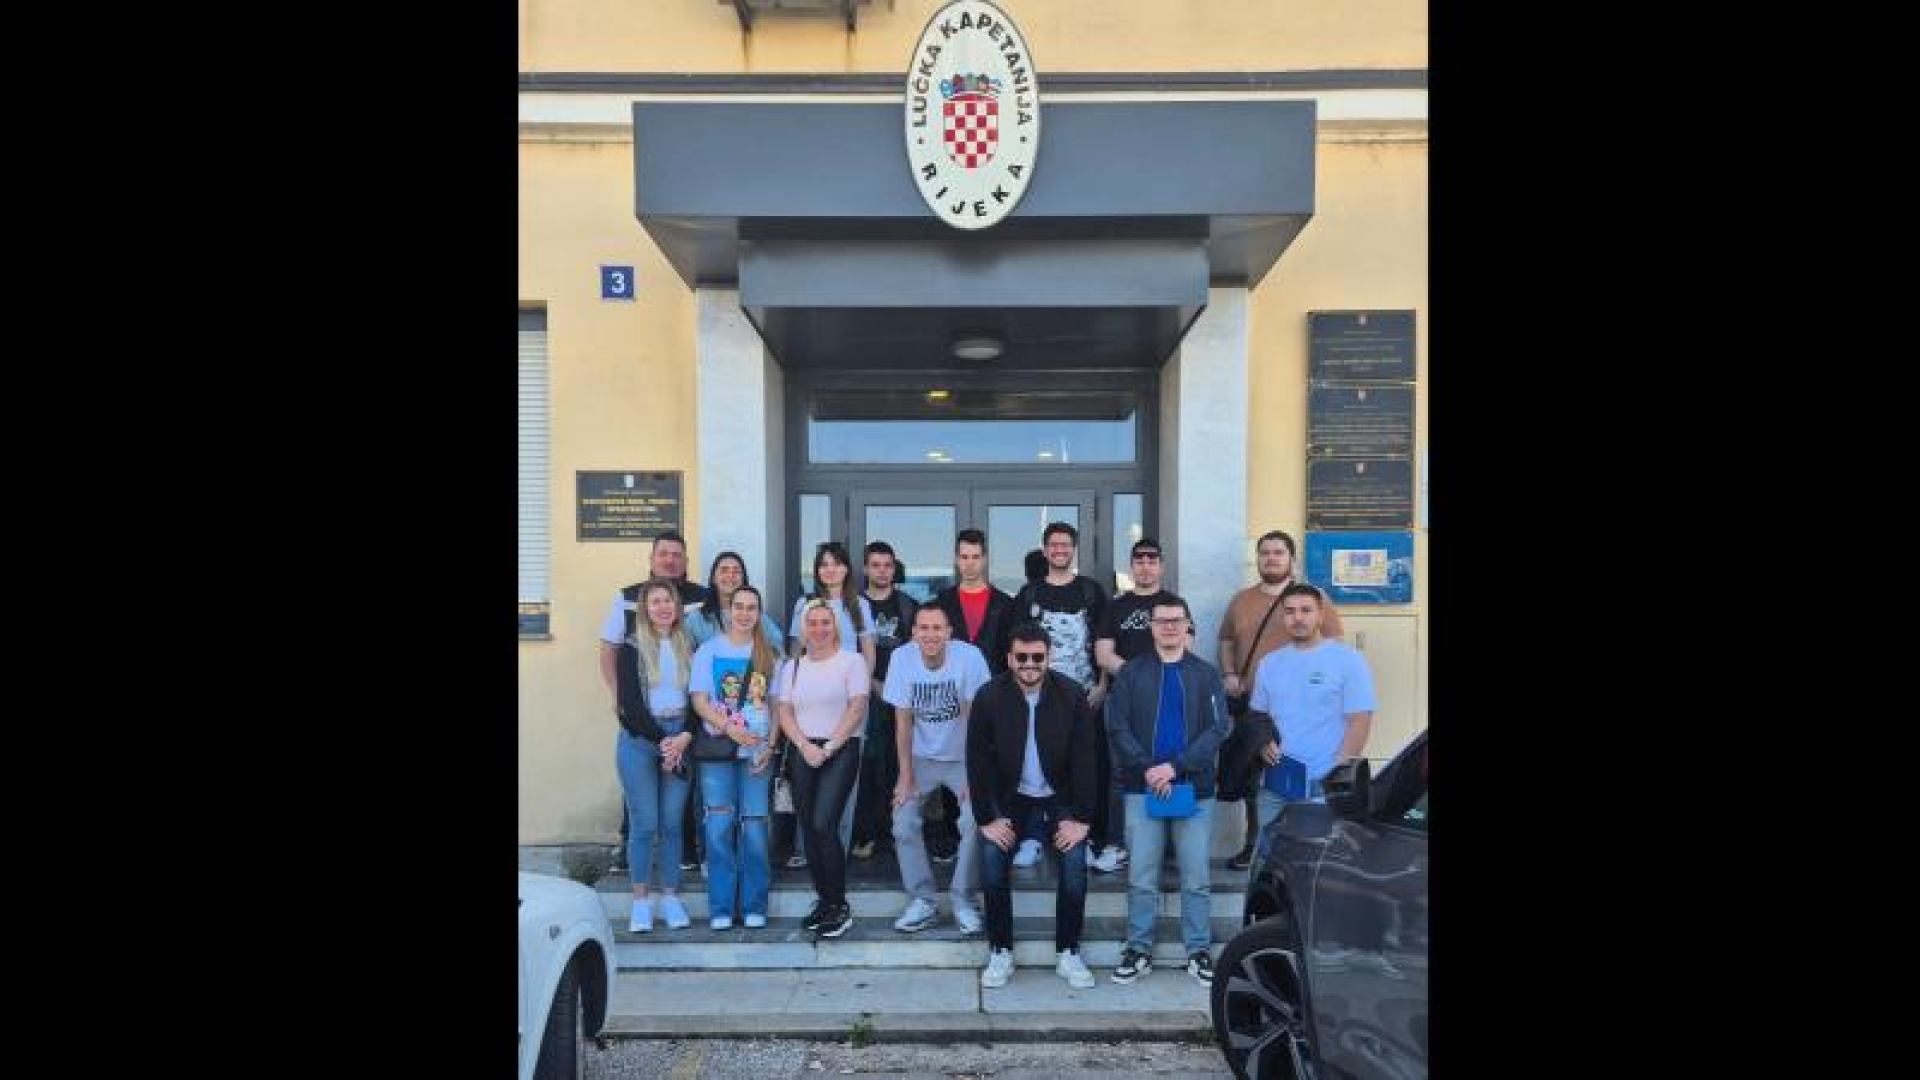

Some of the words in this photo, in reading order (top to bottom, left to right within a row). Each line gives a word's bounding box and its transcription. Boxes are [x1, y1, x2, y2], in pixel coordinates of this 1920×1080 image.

[912, 45, 941, 127] LUČKA
[940, 11, 1032, 126] KAPETANIJA
[922, 163, 1023, 217] RIJEKA
[611, 272, 625, 294] 3
